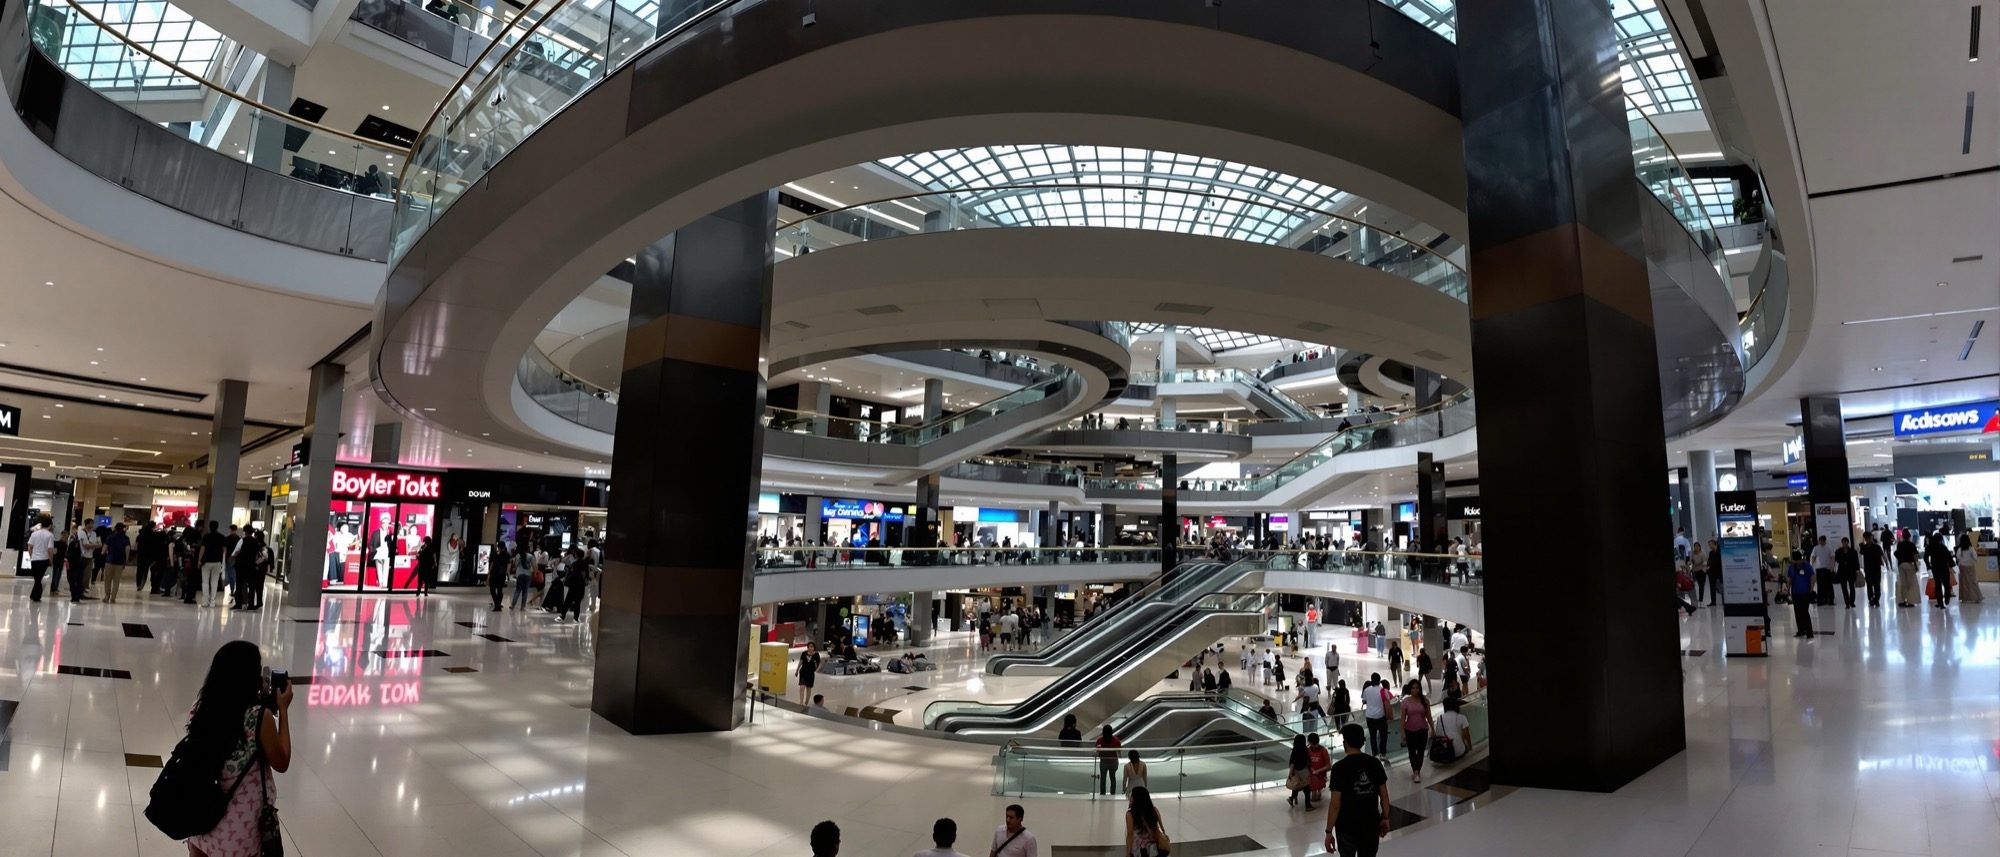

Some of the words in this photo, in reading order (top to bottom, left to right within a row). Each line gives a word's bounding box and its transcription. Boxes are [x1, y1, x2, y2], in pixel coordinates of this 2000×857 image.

[0, 409, 11, 428] M
[332, 470, 396, 499] Boyler
[397, 474, 440, 497] Tokt
